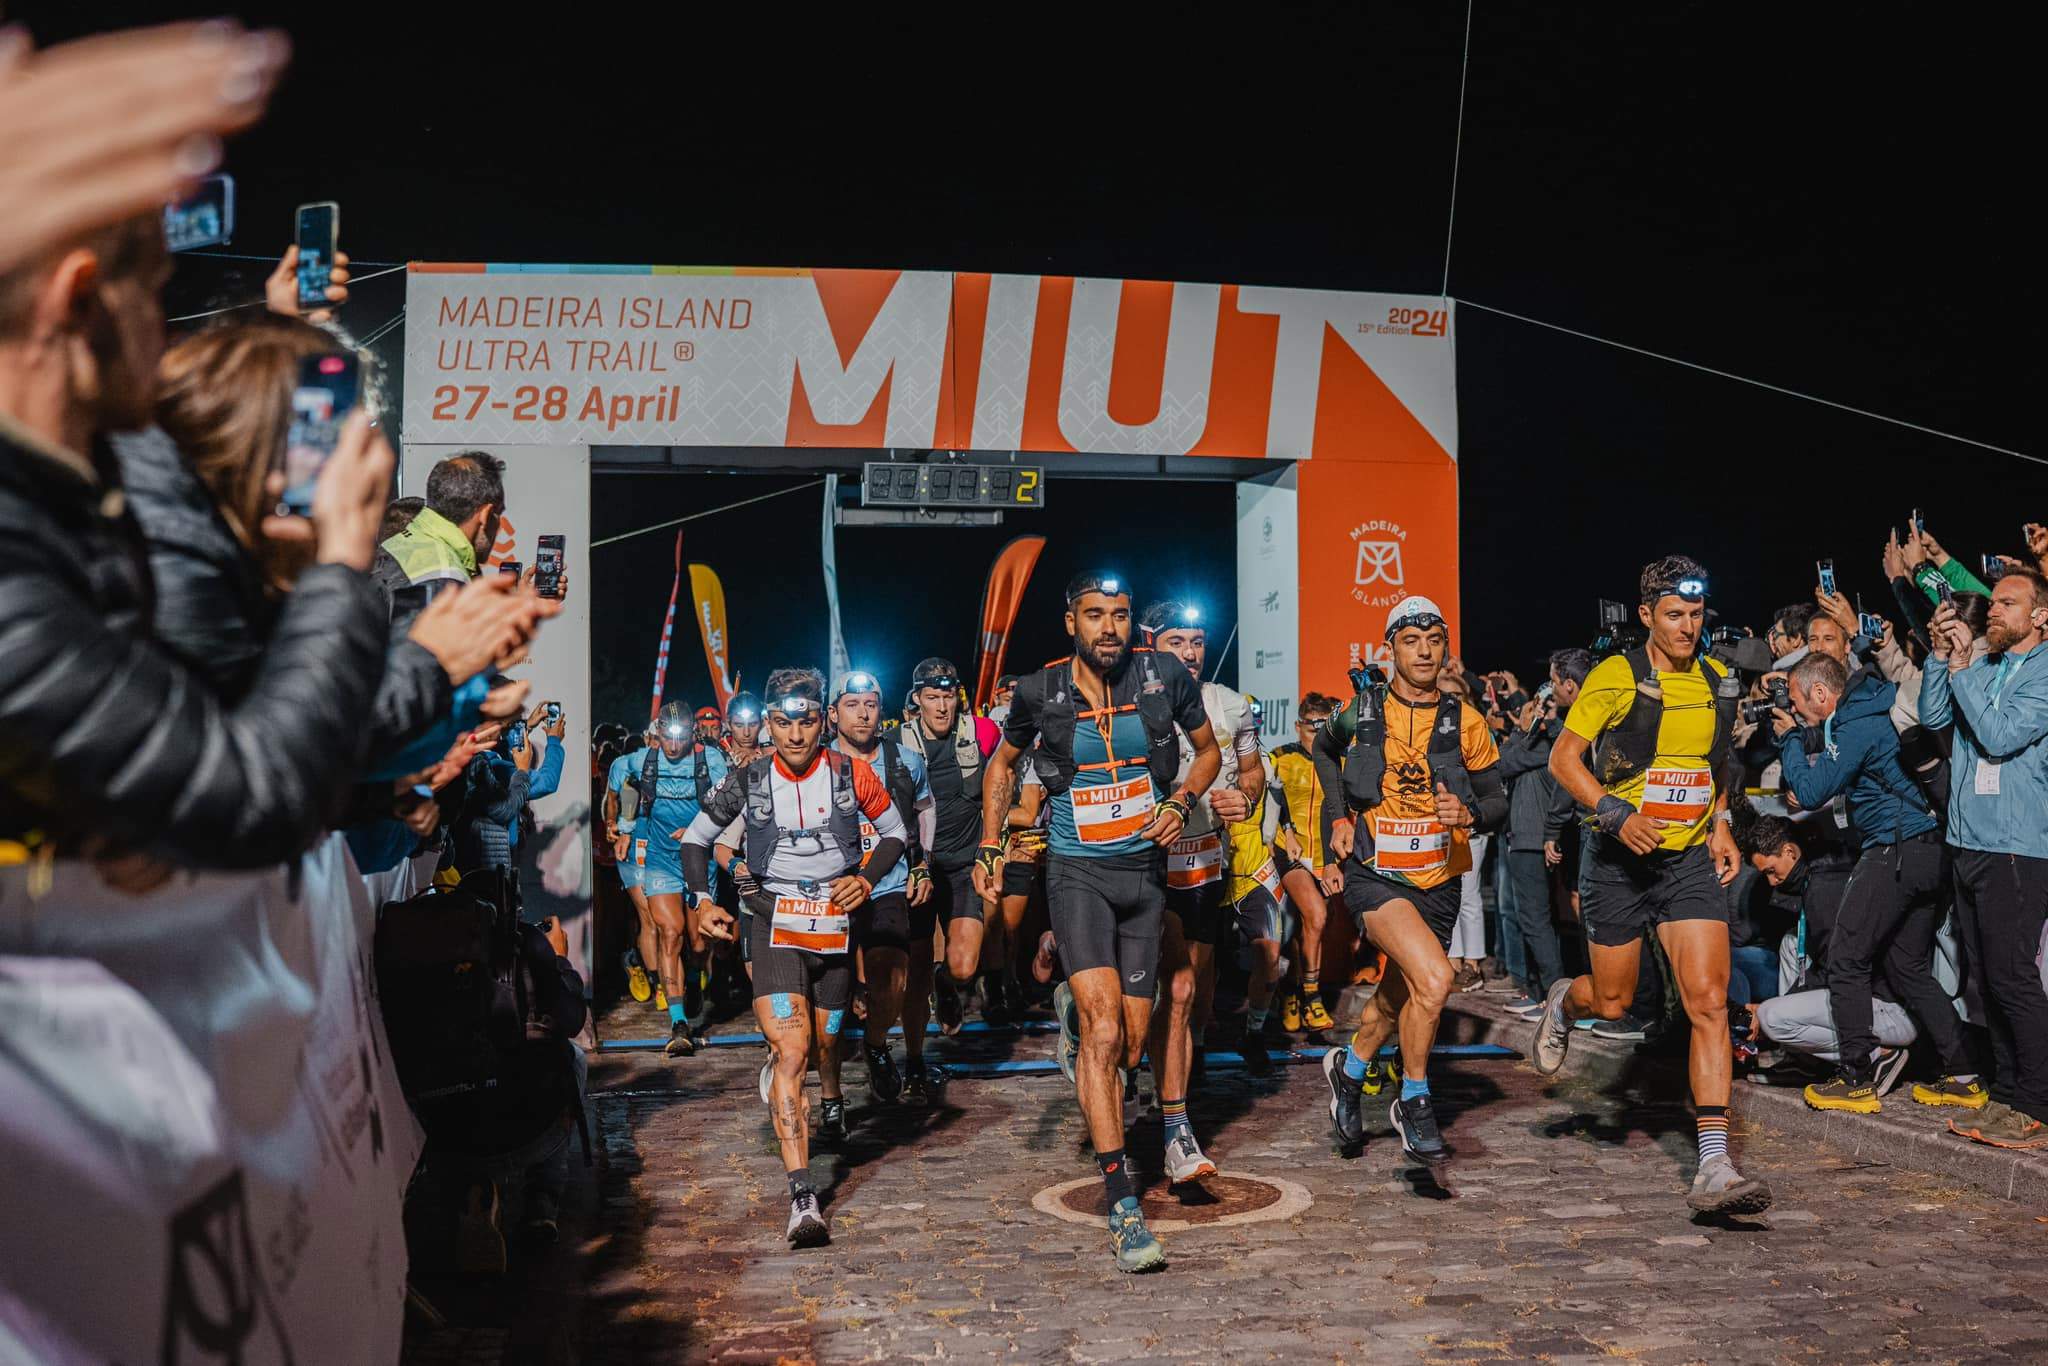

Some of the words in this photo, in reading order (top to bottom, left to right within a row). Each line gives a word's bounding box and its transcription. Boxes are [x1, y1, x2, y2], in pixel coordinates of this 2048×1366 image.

[438, 296, 604, 328] MADEIRA
[618, 297, 752, 330] ISLAND
[1388, 307, 1448, 337] 2024
[437, 339, 551, 372] ULTRA
[787, 268, 1330, 460] MIUT
[431, 384, 569, 421] 27-28
[577, 385, 681, 431] April
[1350, 519, 1407, 542] MADEIRA
[1351, 586, 1408, 607] ISLANDS
[1262, 698, 1290, 737] IUT
[1663, 771, 1698, 786] MIUT
[1089, 785, 1130, 804] MIUT
[1665, 788, 1687, 803] 10
[1111, 803, 1122, 819] 2
[1393, 822, 1431, 836] MIUT
[1169, 840, 1201, 854] MIUT
[1409, 837, 1420, 851] 8
[1186, 855, 1195, 868] 4
[793, 900, 828, 915] MIUT
[807, 918, 817, 932] 1
